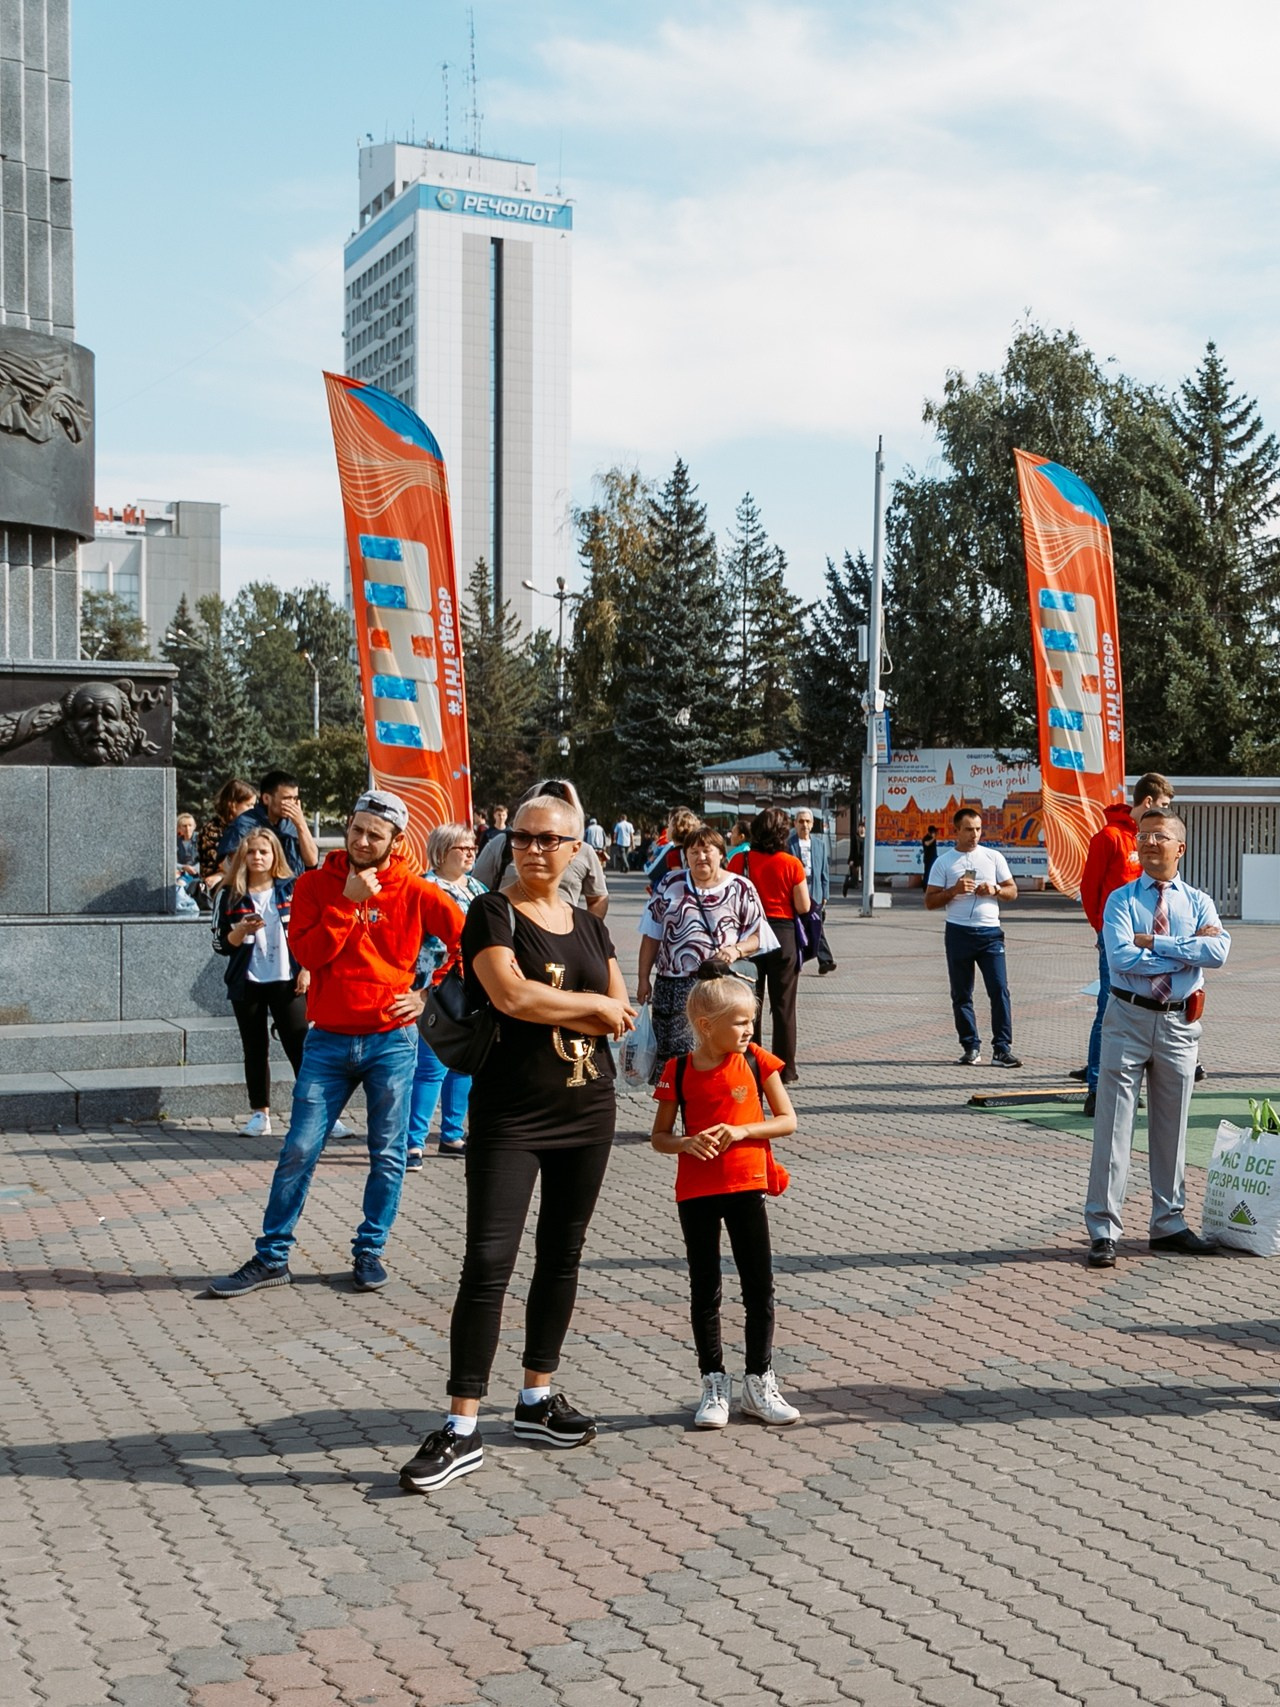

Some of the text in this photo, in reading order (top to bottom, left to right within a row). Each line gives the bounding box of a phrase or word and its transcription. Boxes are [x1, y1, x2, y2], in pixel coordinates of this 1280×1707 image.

[463, 194, 557, 223] РЕЧФЛОТ
[889, 754, 919, 763] ГУСТА
[888, 776, 936, 784] КРАСНОЯРСК
[888, 787, 907, 795] 400
[1245, 1156, 1276, 1176] ВСЕ
[1208, 1169, 1271, 1196] РЗРАЧНО:
[1228, 1203, 1242, 1220] LEROY
[1240, 1200, 1258, 1225] MERLIN
